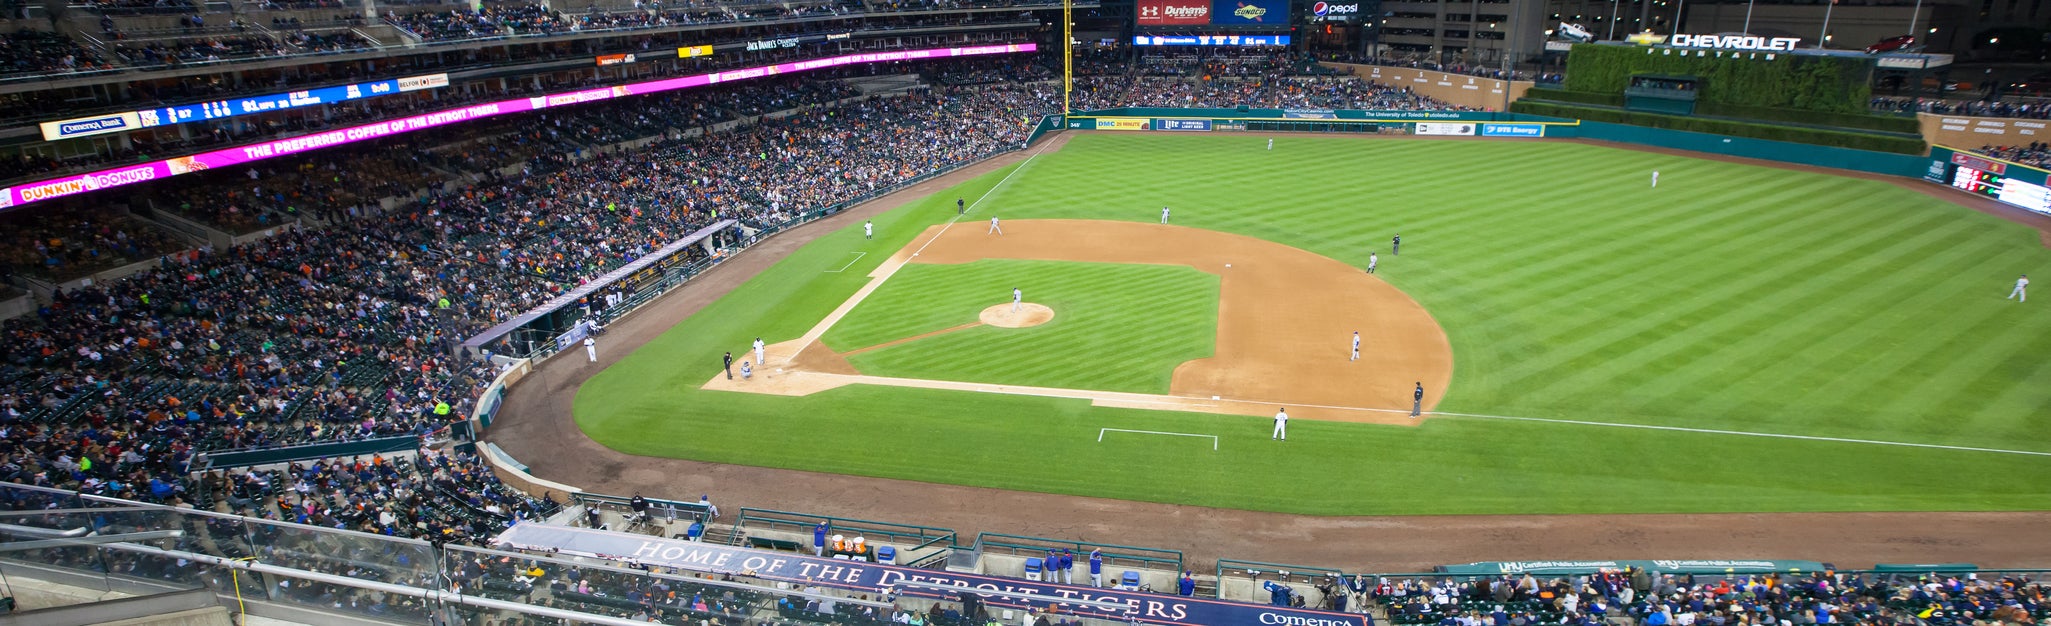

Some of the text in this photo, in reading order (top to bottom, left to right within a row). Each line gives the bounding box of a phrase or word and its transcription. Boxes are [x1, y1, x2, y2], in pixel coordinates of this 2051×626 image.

[1165, 5, 1208, 15] Dunham's
[1329, 3, 1358, 14] pepsi
[747, 41, 758, 51] JACK
[758, 39, 776, 50] DANIEL'S
[1671, 34, 1801, 51] CHEVROLET
[877, 52, 905, 61] DETROIT
[907, 51, 929, 59] TIGERS
[1647, 48, 1776, 60] FOUNTAIN
[399, 80, 419, 88] BELFOR
[101, 118, 122, 128] Bank
[244, 104, 499, 159] THE PREFERRED COFFEE OF THE DETROIT TIGERS
[21, 167, 154, 201] DUNKIN' DONUTS
[633, 540, 1187, 619] HOME OF THE DETROIT TIGERS
